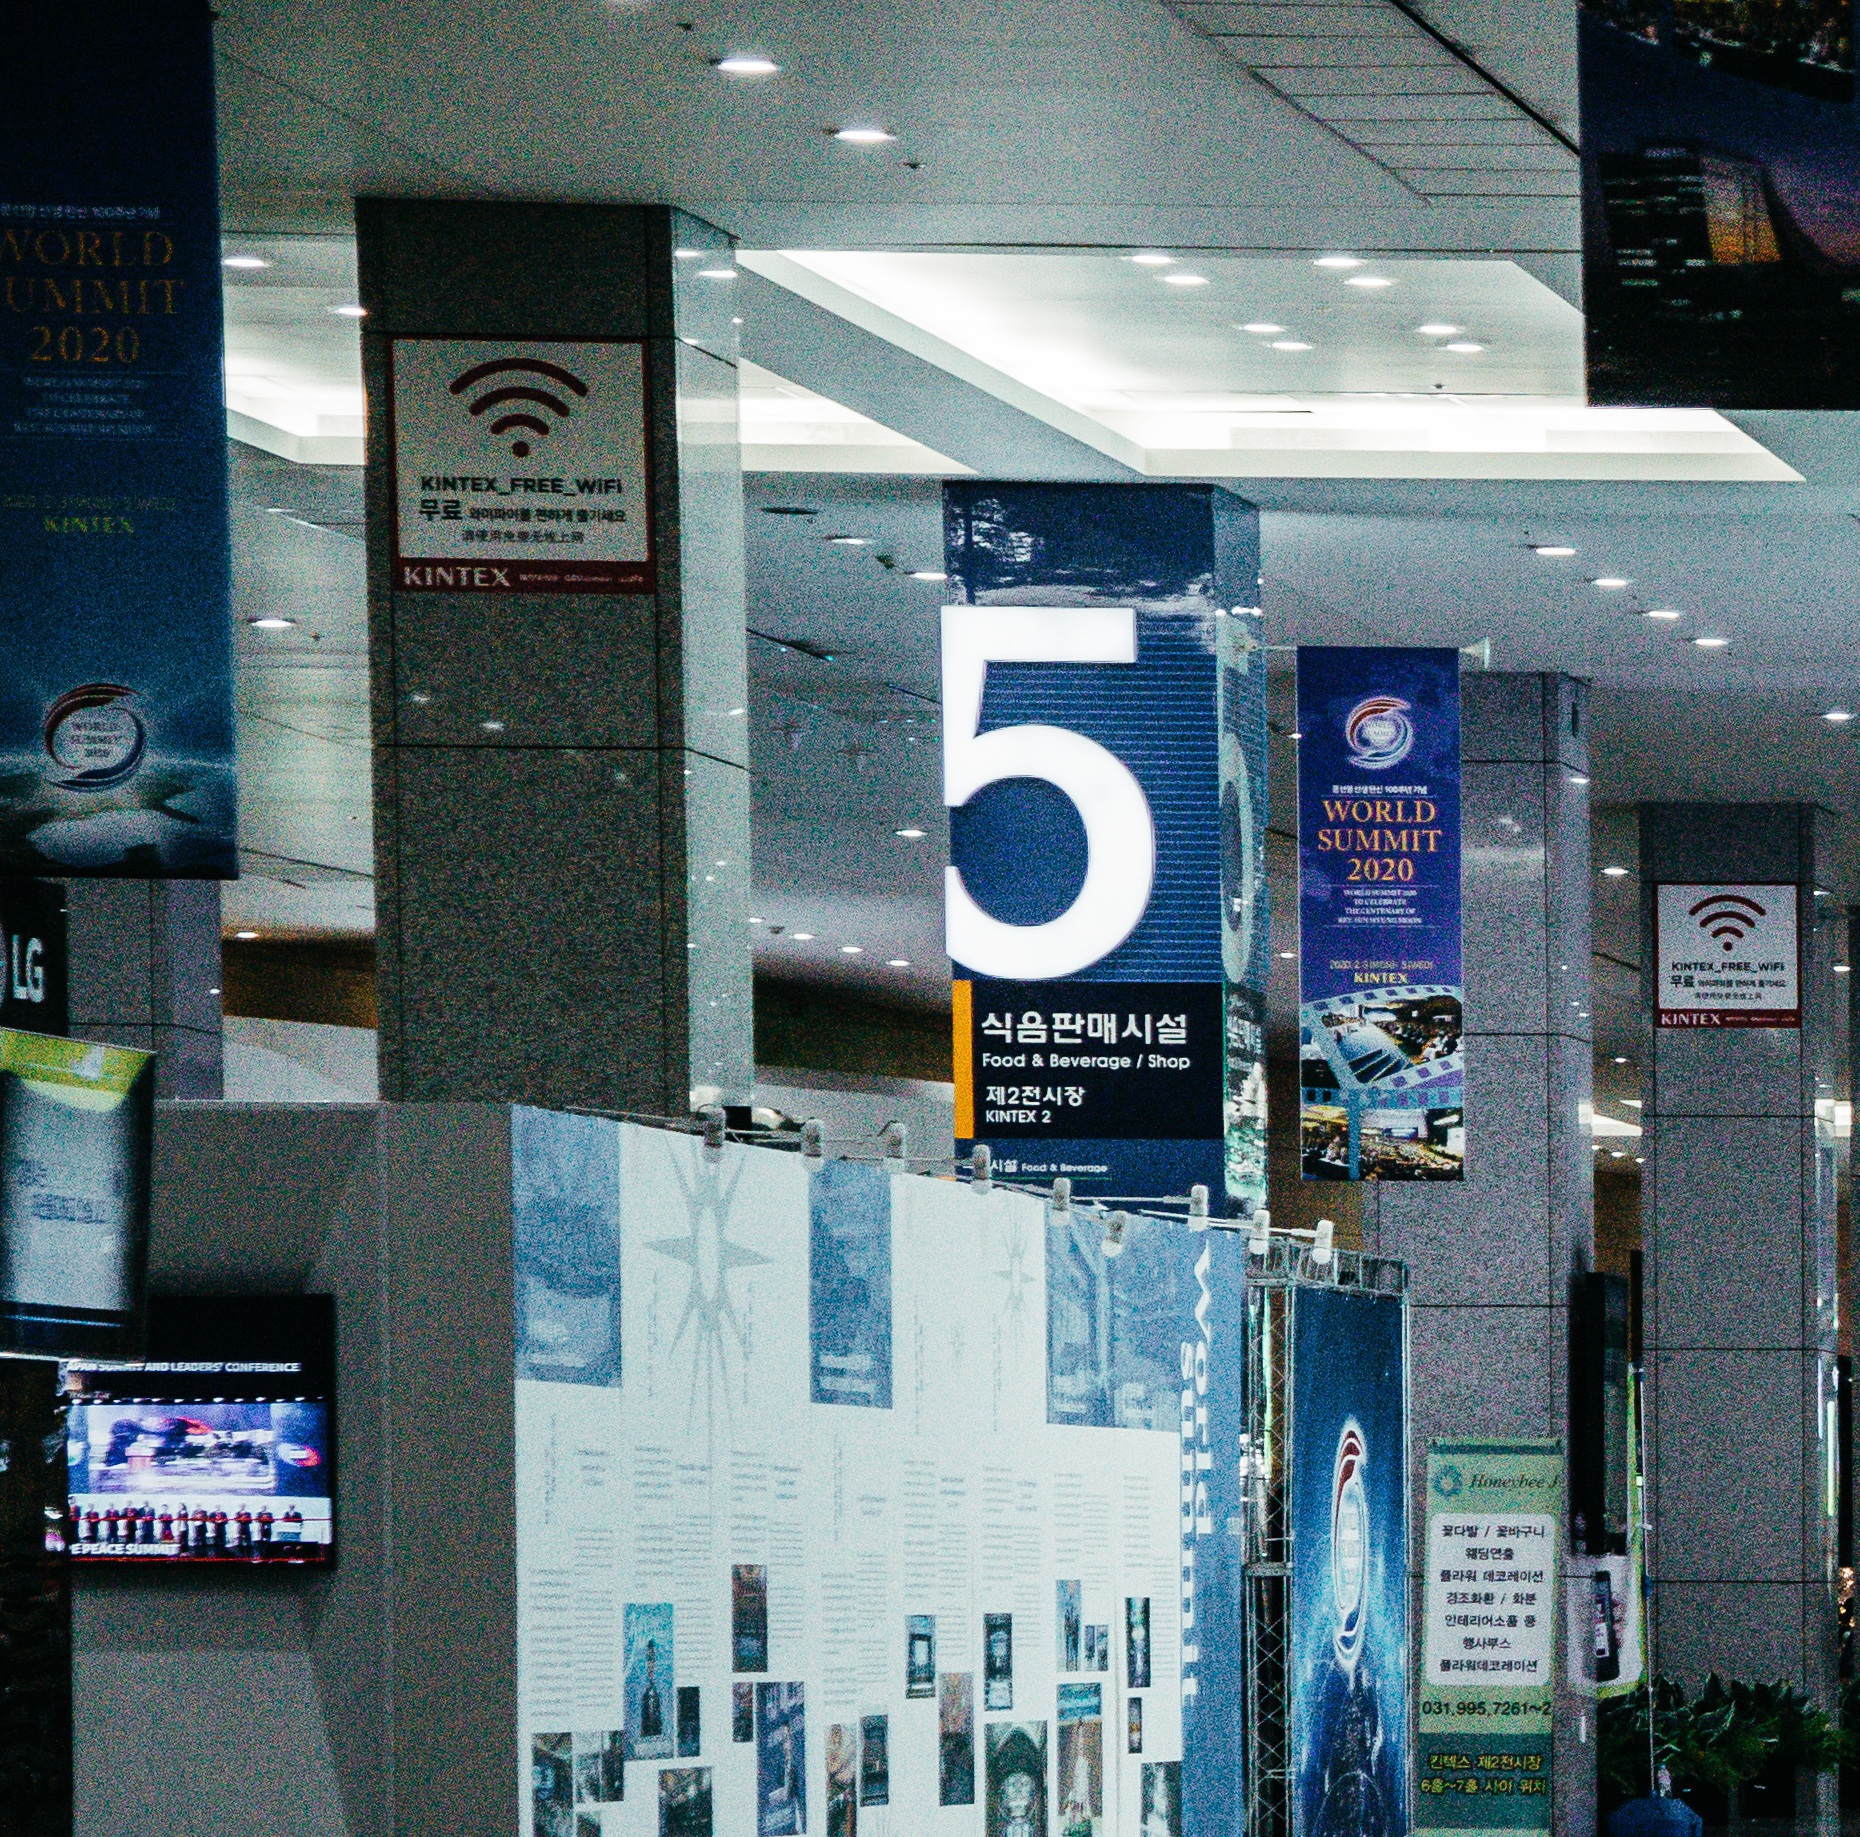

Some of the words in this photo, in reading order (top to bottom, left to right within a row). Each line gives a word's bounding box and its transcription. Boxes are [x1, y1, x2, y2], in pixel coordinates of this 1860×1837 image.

[3, 276, 186, 315] UMMIT
[30, 325, 140, 363] 2020
[419, 499, 462, 521] 무료
[403, 566, 511, 588] KINTEX
[940, 607, 1157, 981] 5
[1322, 800, 1436, 823] WORLD
[1317, 829, 1442, 853] SUMMIT
[1347, 858, 1414, 881] 2020
[12, 934, 44, 1003] LG
[1354, 972, 1408, 983] KINTEX
[1670, 975, 1694, 988] 무료
[1661, 1013, 1721, 1025] KINTEX
[981, 1011, 1188, 1045] 식음판매시설
[982, 1053, 1026, 1069] Food
[1032, 1053, 1044, 1068] &
[1049, 1053, 1131, 1071] Beverage
[1147, 1054, 1191, 1071] Shop
[985, 1085, 1086, 1108] 제2전시장
[985, 1109, 1037, 1124] KINTEX
[1041, 1109, 1052, 1124] 2
[990, 1159, 1018, 1173] 시설
[1022, 1163, 1046, 1172] Food
[1050, 1163, 1058, 1172] &
[1060, 1163, 1108, 1173] Beverage
[145, 1362, 169, 1372] AND
[225, 1362, 301, 1372] CONFERENCE
[1470, 1474, 1546, 1491] Honeybee
[1442, 1525, 1478, 1537] 꽃다발
[1496, 1525, 1545, 1538] 꽃바구니
[82, 1543, 125, 1555] PEACE
[1483, 1570, 1544, 1583] 데코레이션
[1484, 1778, 1513, 1794] 사이
